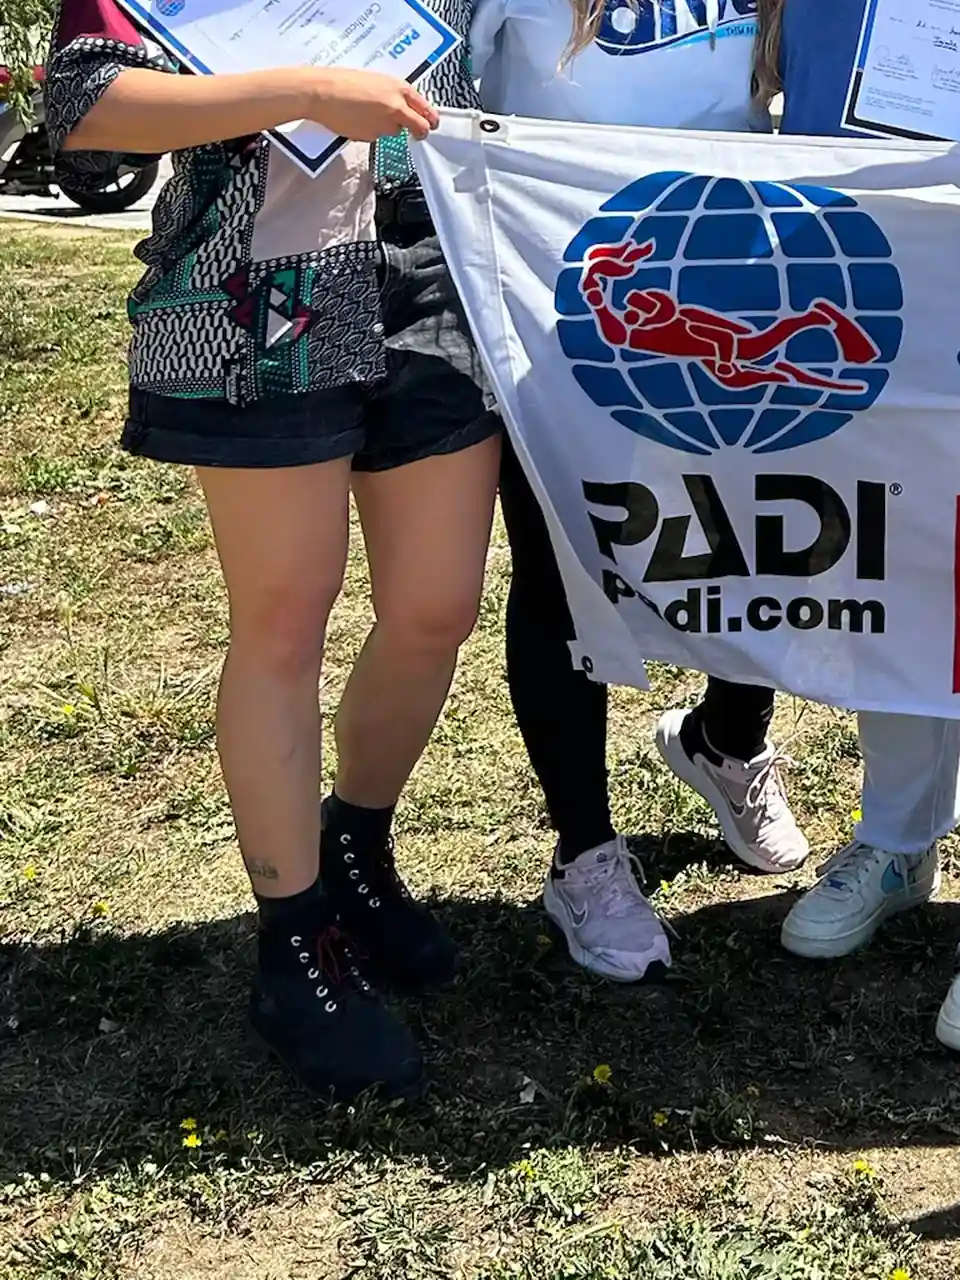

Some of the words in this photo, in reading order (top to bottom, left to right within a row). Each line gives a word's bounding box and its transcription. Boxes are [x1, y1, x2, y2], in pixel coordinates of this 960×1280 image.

[338, 2, 382, 42] Certificate
[388, 28, 420, 60] PADI
[581, 473, 887, 584] PADI
[601, 568, 886, 634] pdi.com
